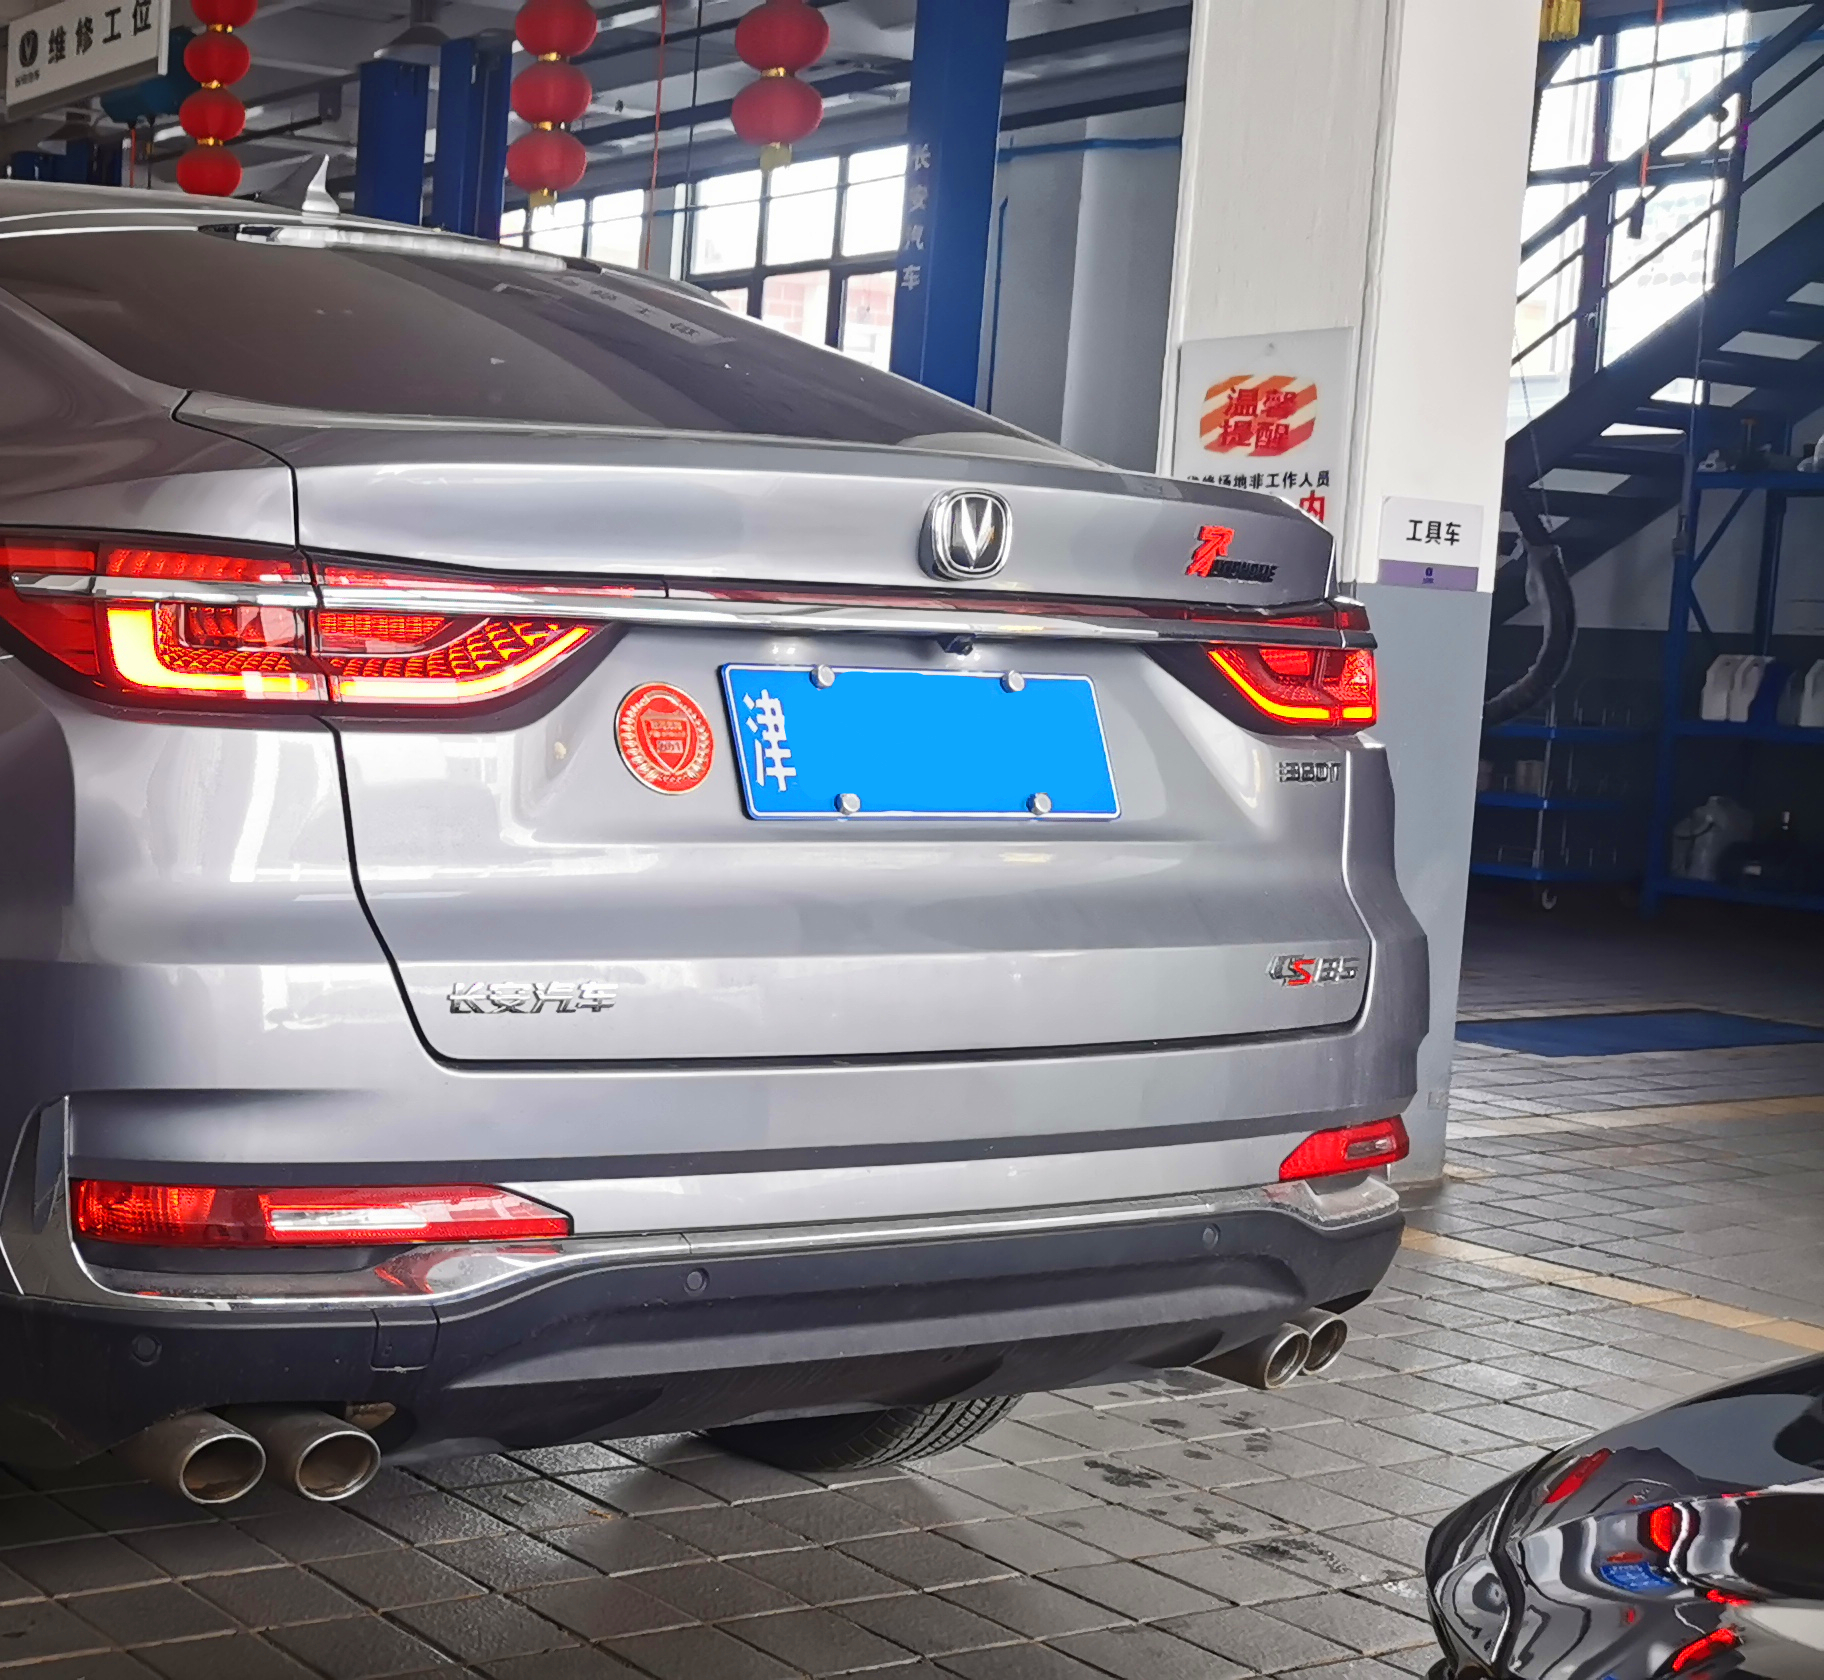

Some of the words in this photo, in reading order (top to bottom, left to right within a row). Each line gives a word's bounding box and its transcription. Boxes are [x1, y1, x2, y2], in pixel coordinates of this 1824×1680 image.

[47, 0, 153, 64] 维修工位
[1224, 387, 1297, 418] 温馨
[1219, 418, 1290, 449] 提醒
[1405, 519, 1462, 547] 工具车
[743, 689, 797, 792] 津
[446, 981, 619, 1014] 长安汽车
